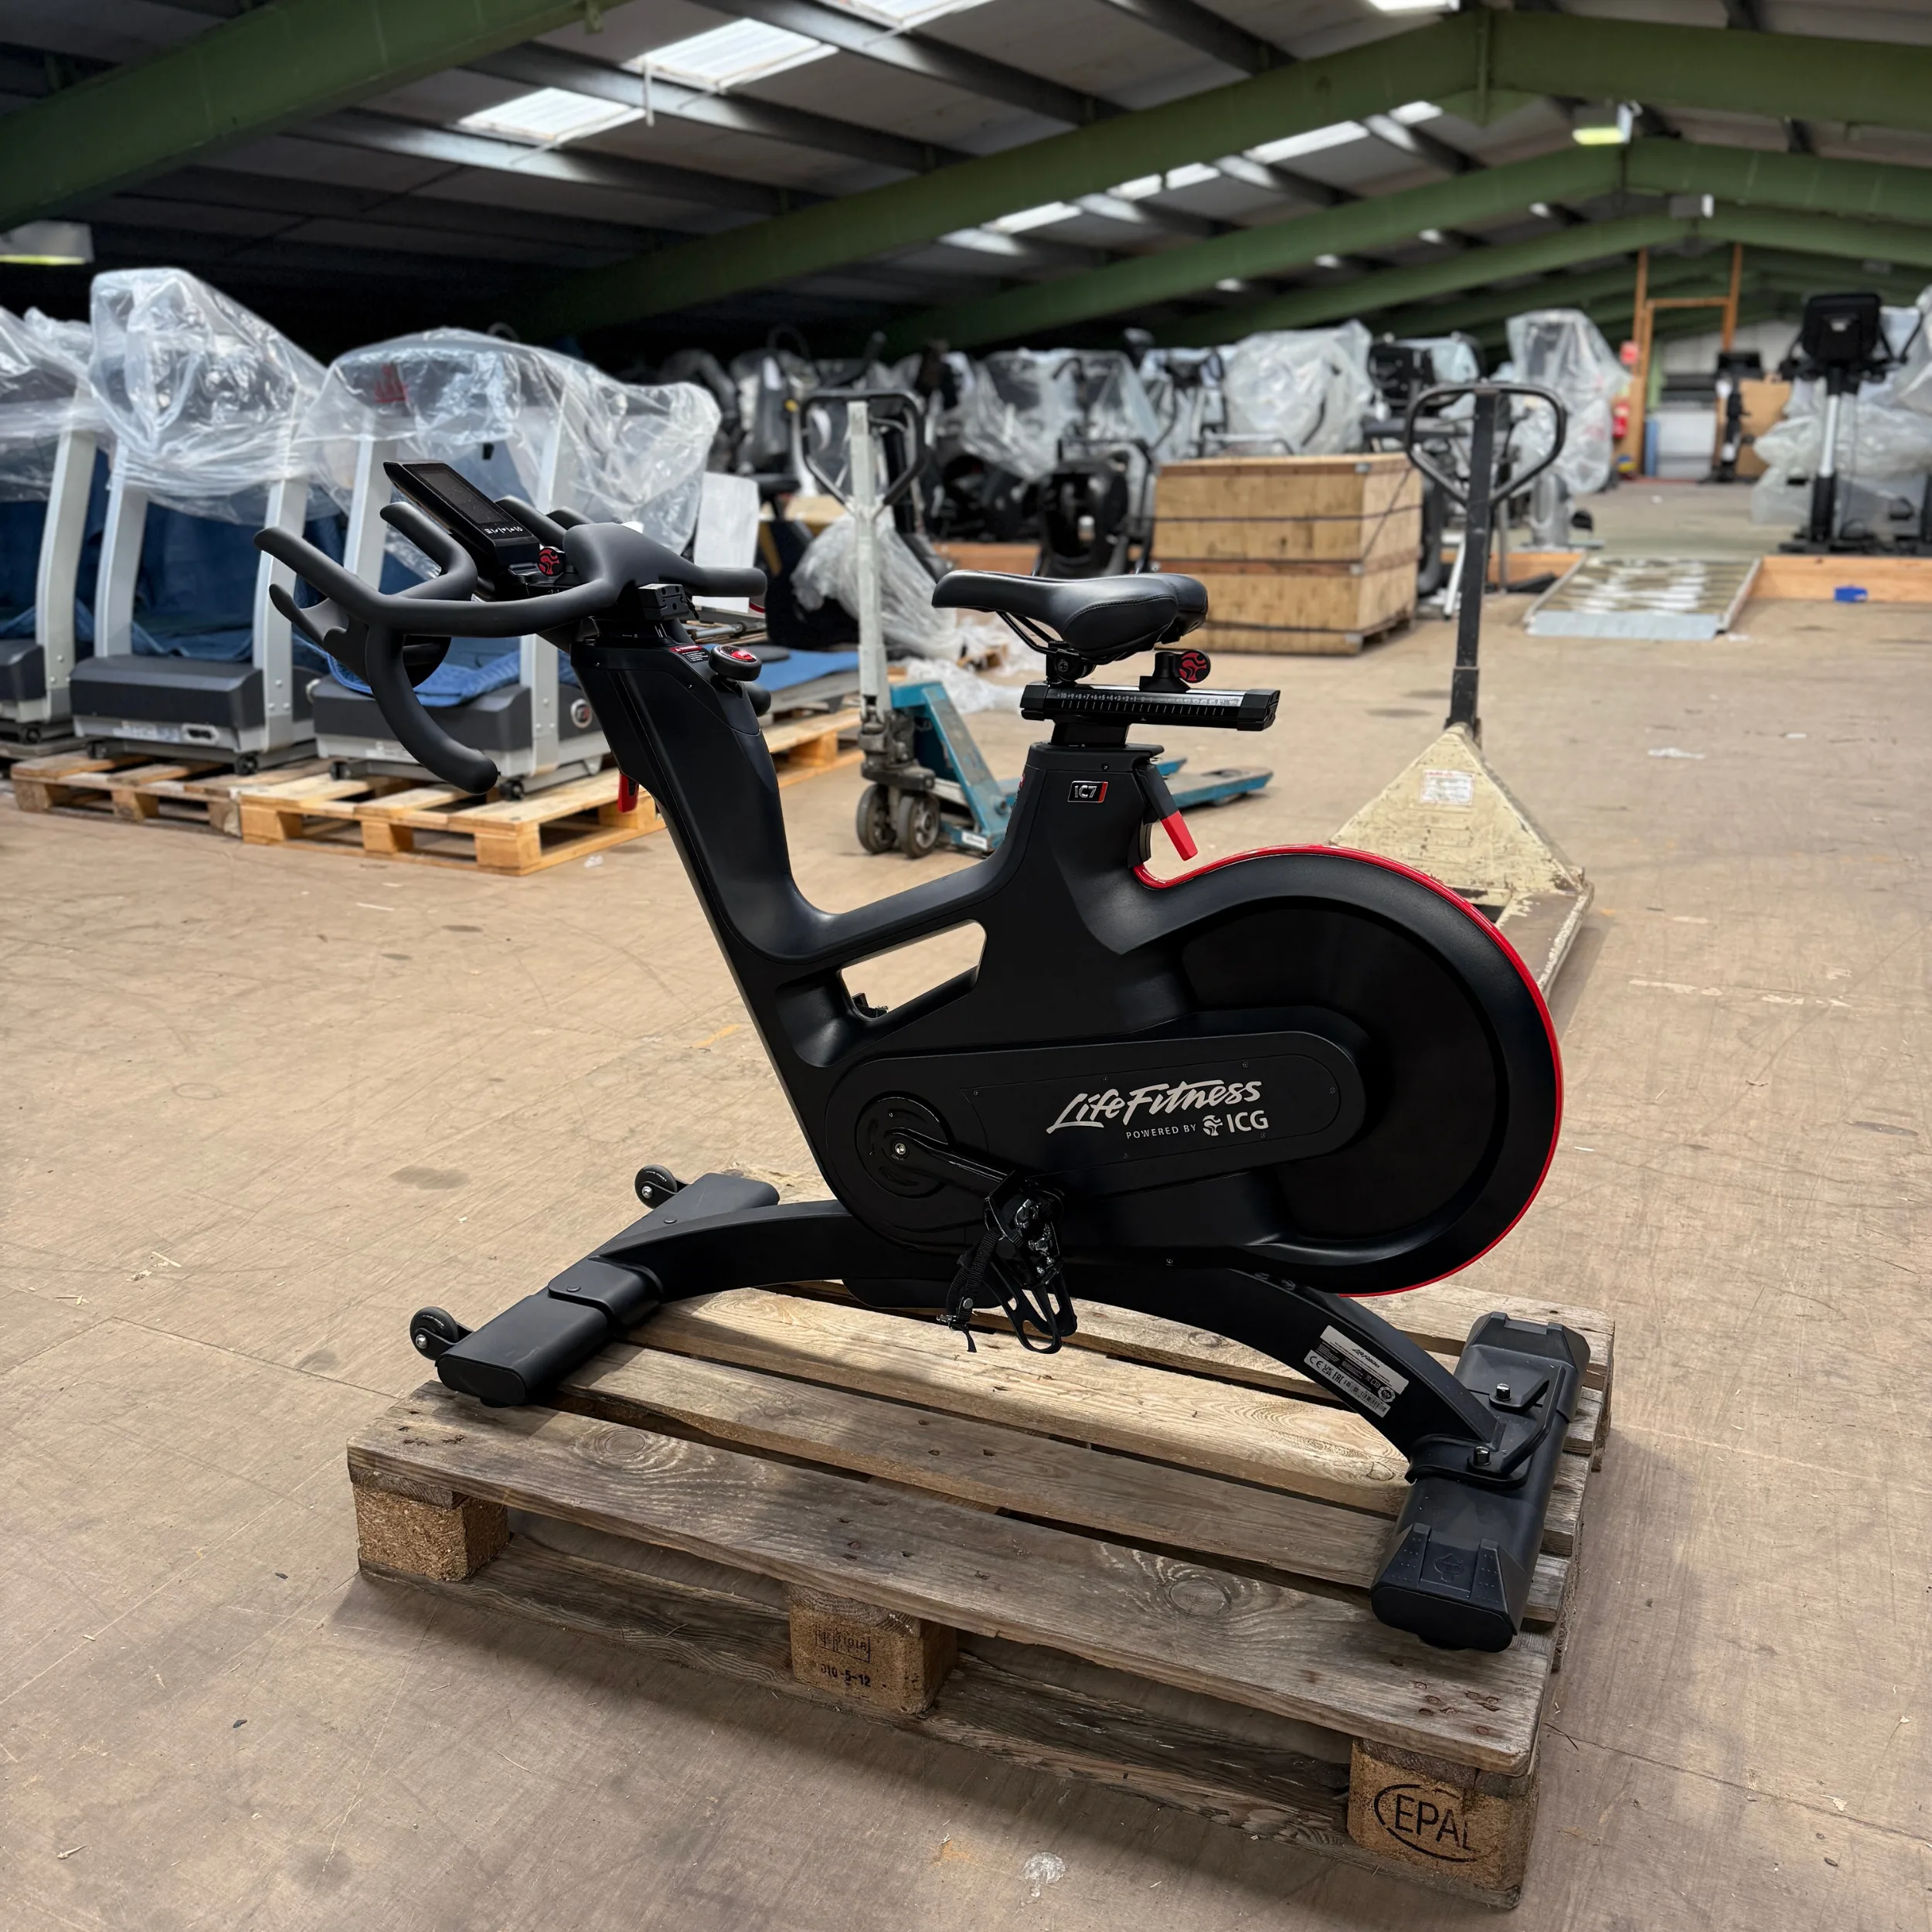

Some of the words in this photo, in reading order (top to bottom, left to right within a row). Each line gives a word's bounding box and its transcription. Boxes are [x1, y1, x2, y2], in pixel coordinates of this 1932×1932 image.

[1126, 1126, 1179, 1140] POWERED
[1183, 1124, 1196, 1133] BY
[1226, 1110, 1269, 1133] ICG
[1394, 1793, 1481, 1853] EPAL
